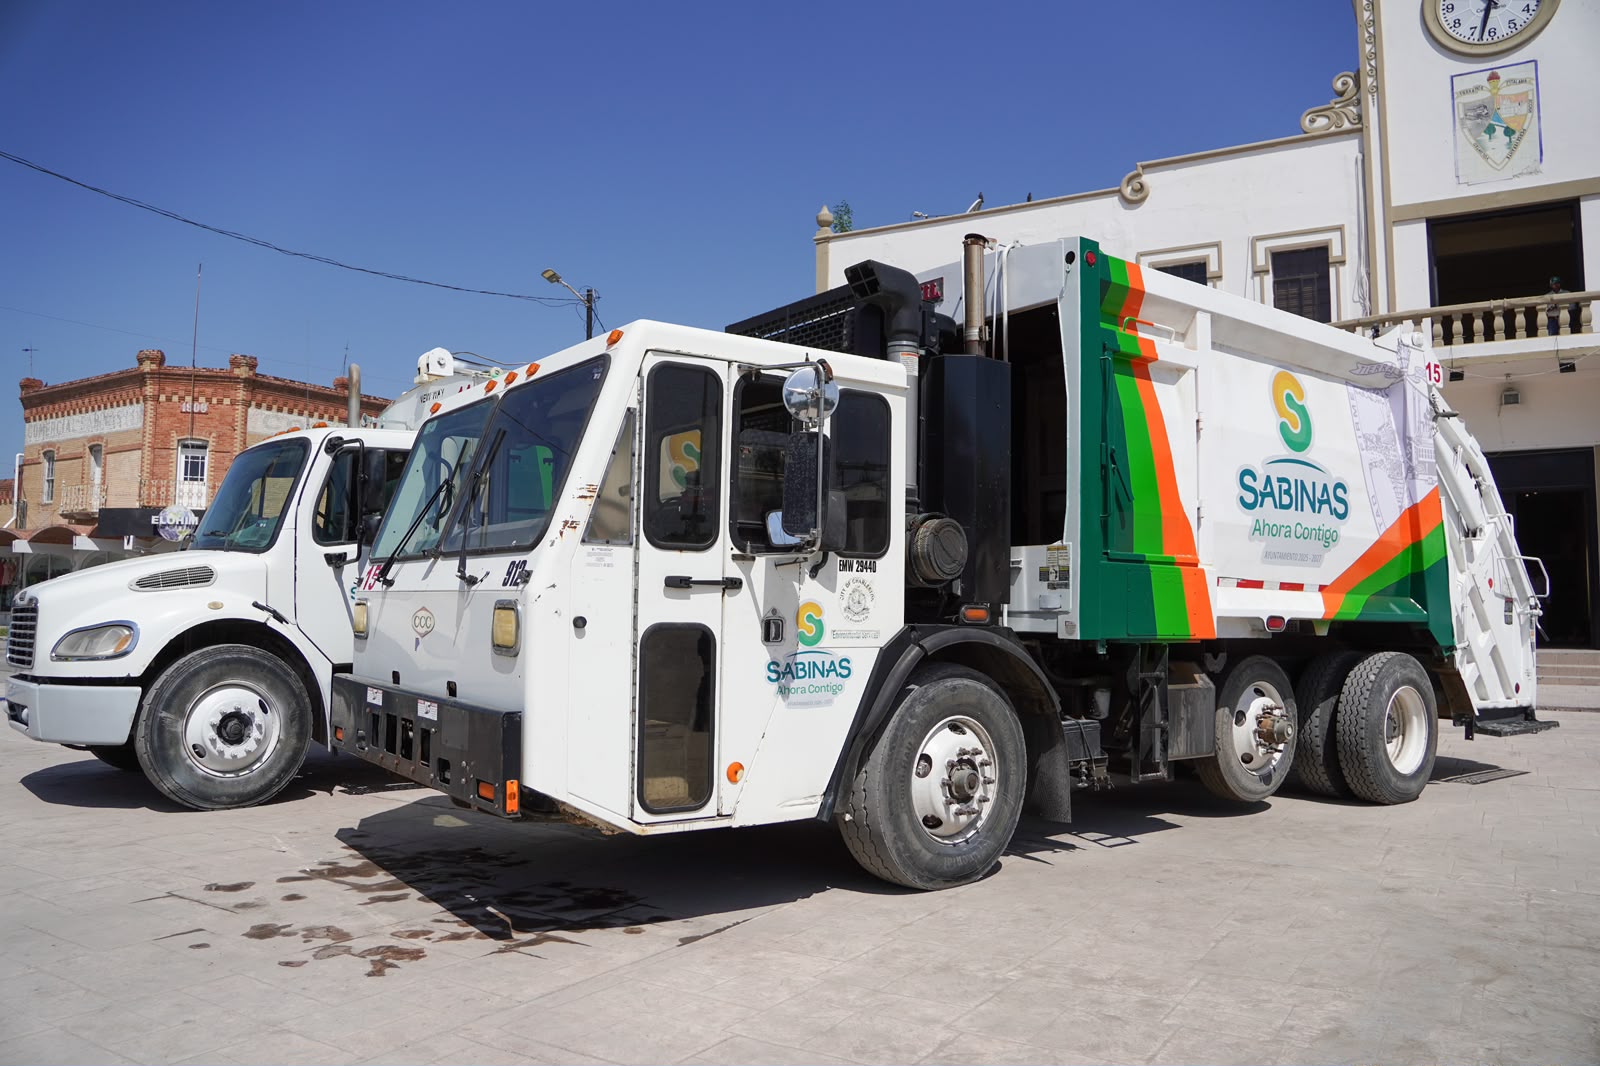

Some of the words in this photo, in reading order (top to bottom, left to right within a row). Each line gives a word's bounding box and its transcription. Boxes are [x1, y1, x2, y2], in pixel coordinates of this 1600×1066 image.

[1446, 3, 1454, 13] 9
[1522, 4, 1530, 13] 4
[1453, 18, 1461, 28] 8
[1508, 19, 1517, 29] 5
[1470, 26, 1477, 37] 7
[1488, 28, 1496, 37] 6
[1426, 362, 1441, 383] 15
[1239, 468, 1349, 520] SABINAS
[151, 515, 199, 525] ELOHIM
[1252, 519, 1292, 538] Ahora
[1294, 522, 1338, 548] Contigo
[1264, 551, 1298, 561] AYUNTAMIENTO
[839, 560, 854, 572] EMW
[363, 565, 382, 590] 15
[502, 560, 528, 587] 912
[414, 615, 432, 629] CCC
[767, 658, 851, 682] SABINAS
[776, 684, 806, 696] Ahora
[808, 683, 843, 695] Contigo
